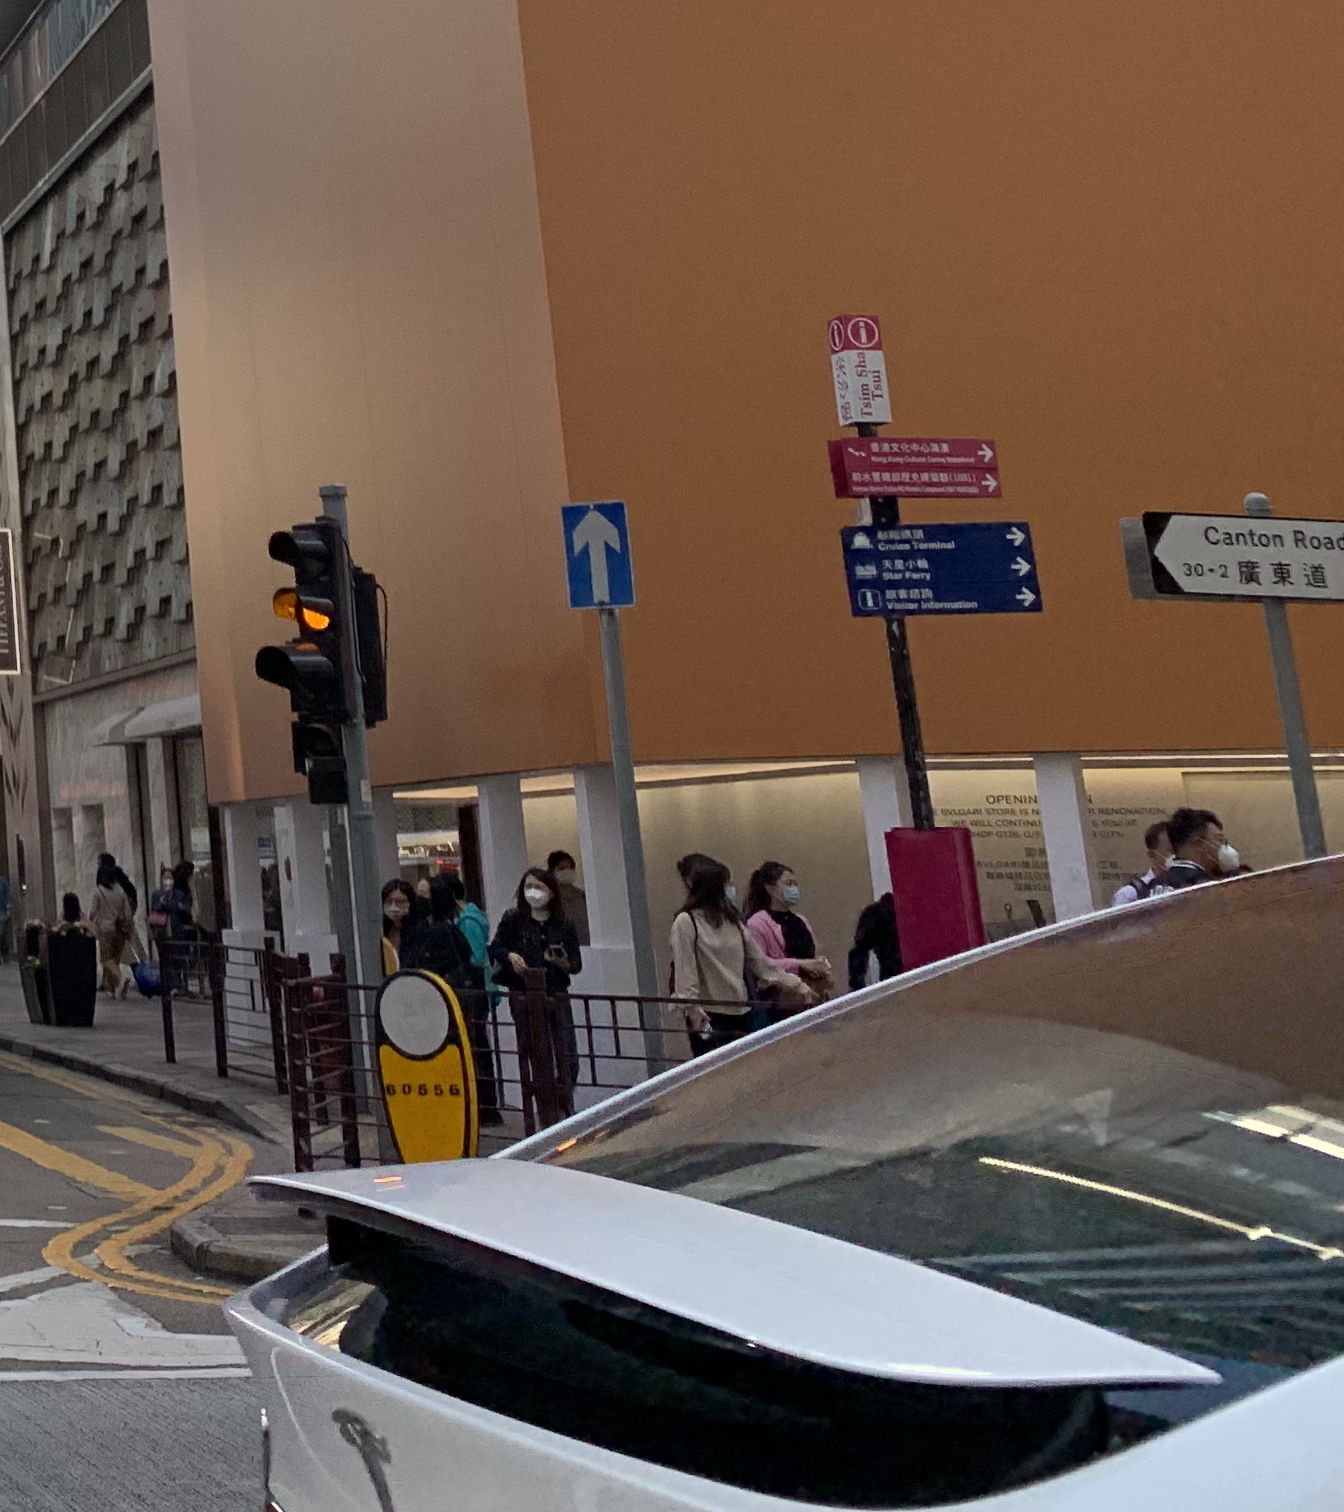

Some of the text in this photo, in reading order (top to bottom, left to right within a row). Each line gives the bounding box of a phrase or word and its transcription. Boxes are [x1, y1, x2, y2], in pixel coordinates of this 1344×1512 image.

[1204, 526, 1285, 548] Canton
[912, 539, 956, 550] Terminal
[883, 571, 931, 581] Star Ferry
[1238, 559, 1329, 589] 廣東道
[921, 600, 979, 609] Information
[995, 819, 1041, 827] CONTINU
